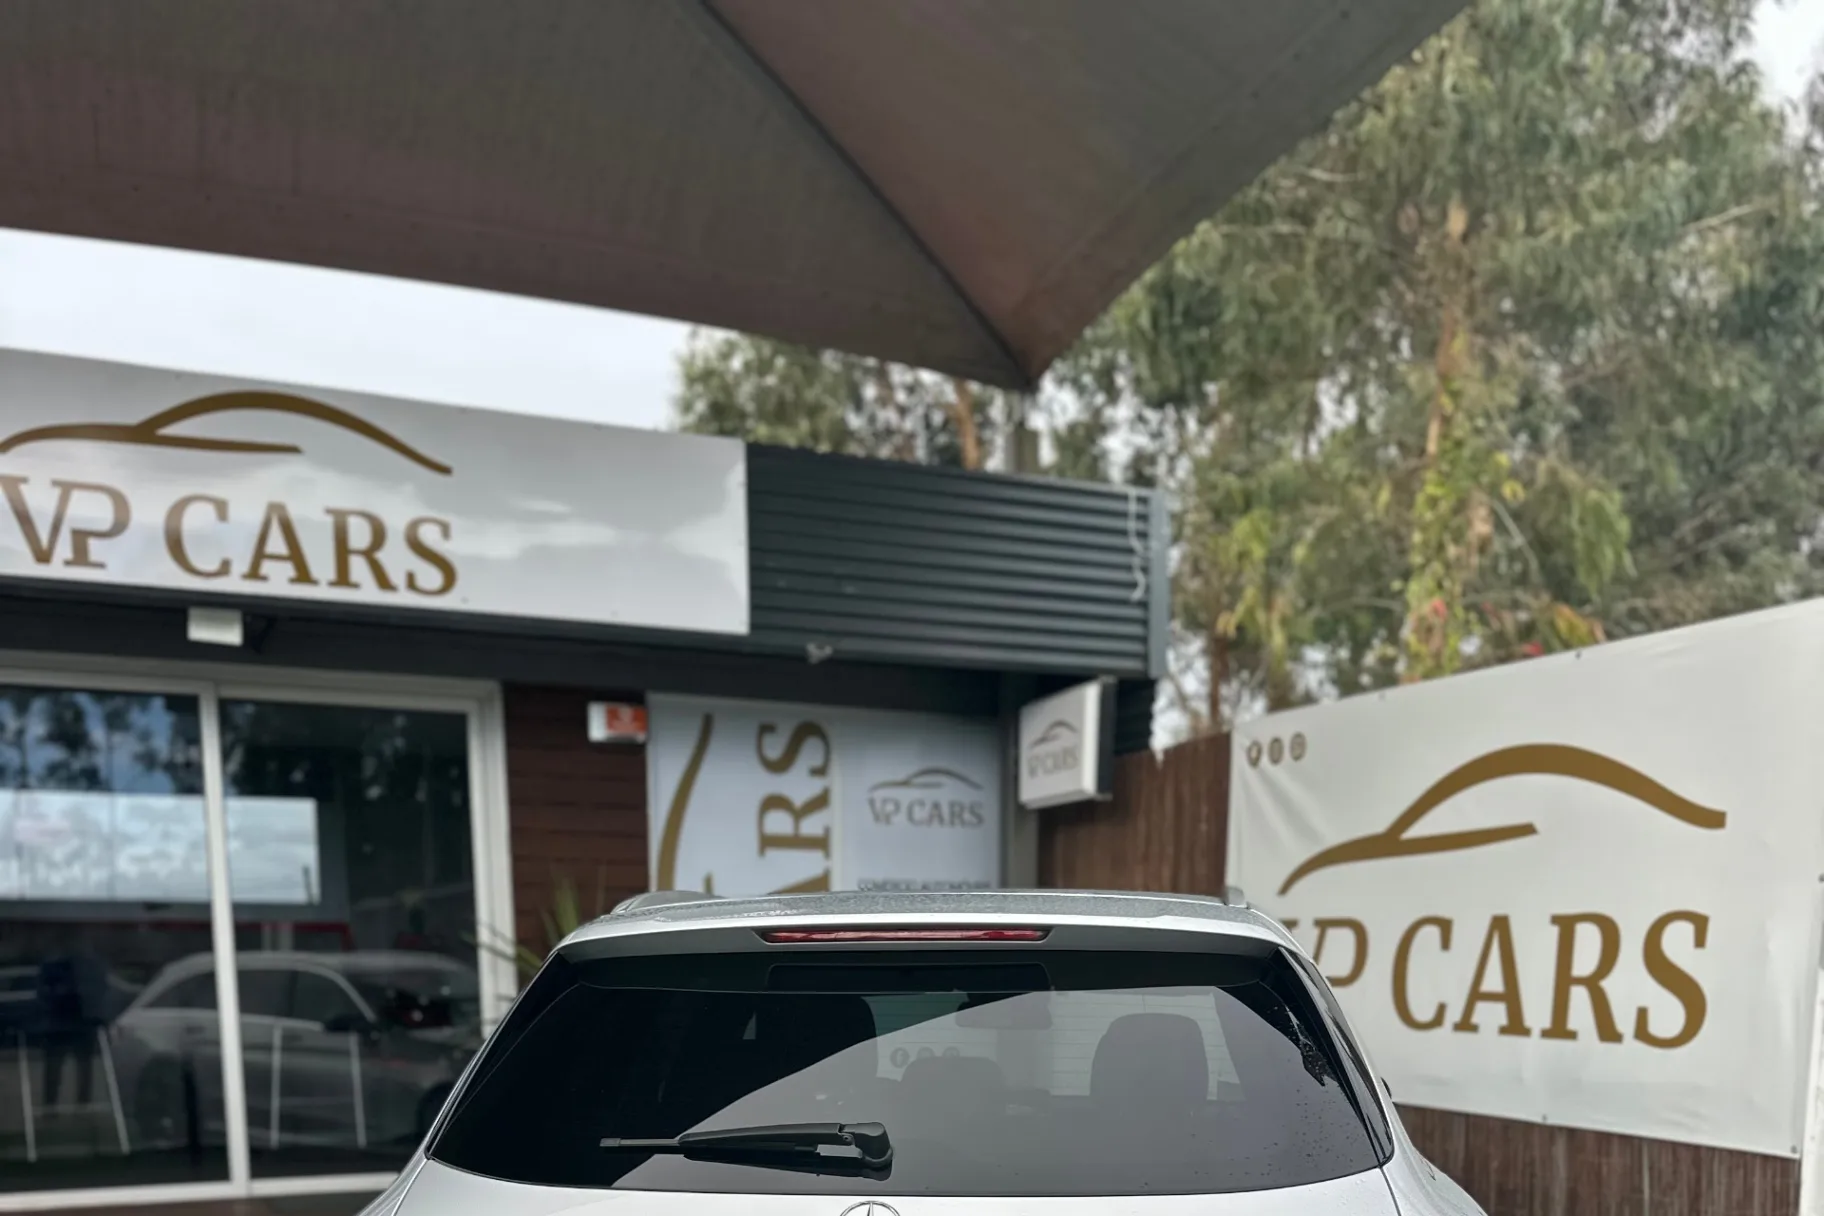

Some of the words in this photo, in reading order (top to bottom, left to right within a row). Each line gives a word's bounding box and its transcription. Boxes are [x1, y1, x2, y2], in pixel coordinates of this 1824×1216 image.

[0, 474, 132, 569] VP
[163, 493, 458, 597] CARS
[867, 796, 901, 826] VP
[906, 798, 985, 830] CARS
[1391, 909, 1710, 1050] CARS
